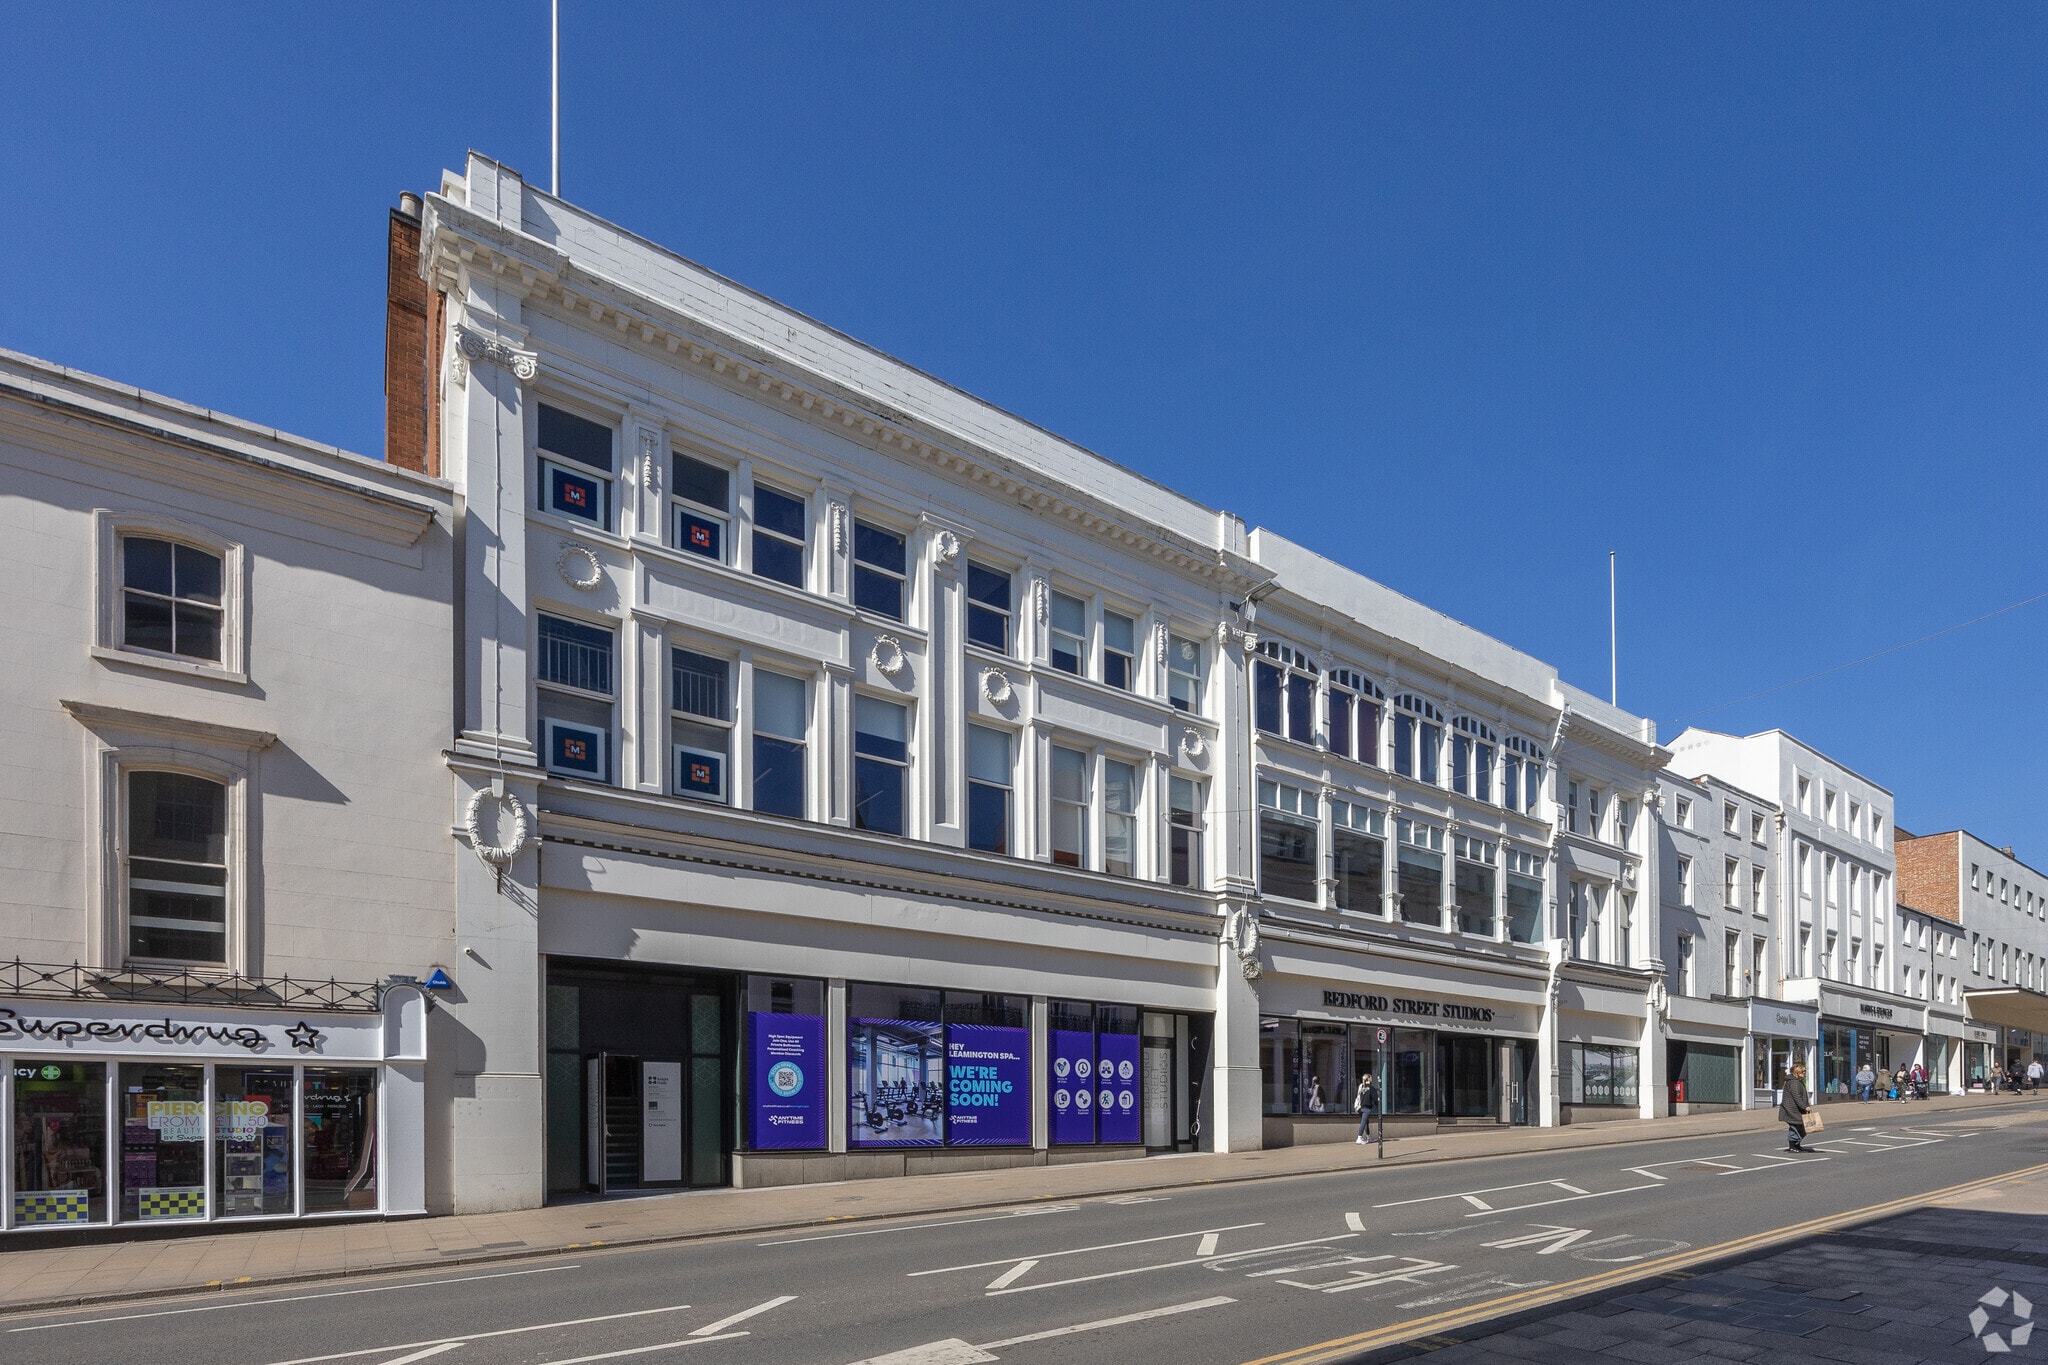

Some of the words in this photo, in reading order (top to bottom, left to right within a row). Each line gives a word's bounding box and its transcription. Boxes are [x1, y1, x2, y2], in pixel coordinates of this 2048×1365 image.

[570, 491, 580, 500] M
[696, 532, 705, 541] M
[570, 745, 580, 754] M
[696, 769, 705, 778] M
[1322, 990, 1388, 1011] BEDFORD
[1393, 998, 1440, 1017] STREET
[1443, 1004, 1493, 1022] STUDIOS
[0, 1008, 267, 1048] Superdrug
[949, 1043, 965, 1051] HEY
[949, 1051, 999, 1059] LEAMINGTON
[1000, 1052, 1020, 1060] SPA...
[949, 1065, 998, 1079] WE'RE
[949, 1079, 1013, 1093] COMING
[949, 1093, 999, 1107] SOON!
[150, 1102, 267, 1115] PIERCING
[150, 1116, 200, 1127] FROM
[215, 1116, 267, 1126] £11.50
